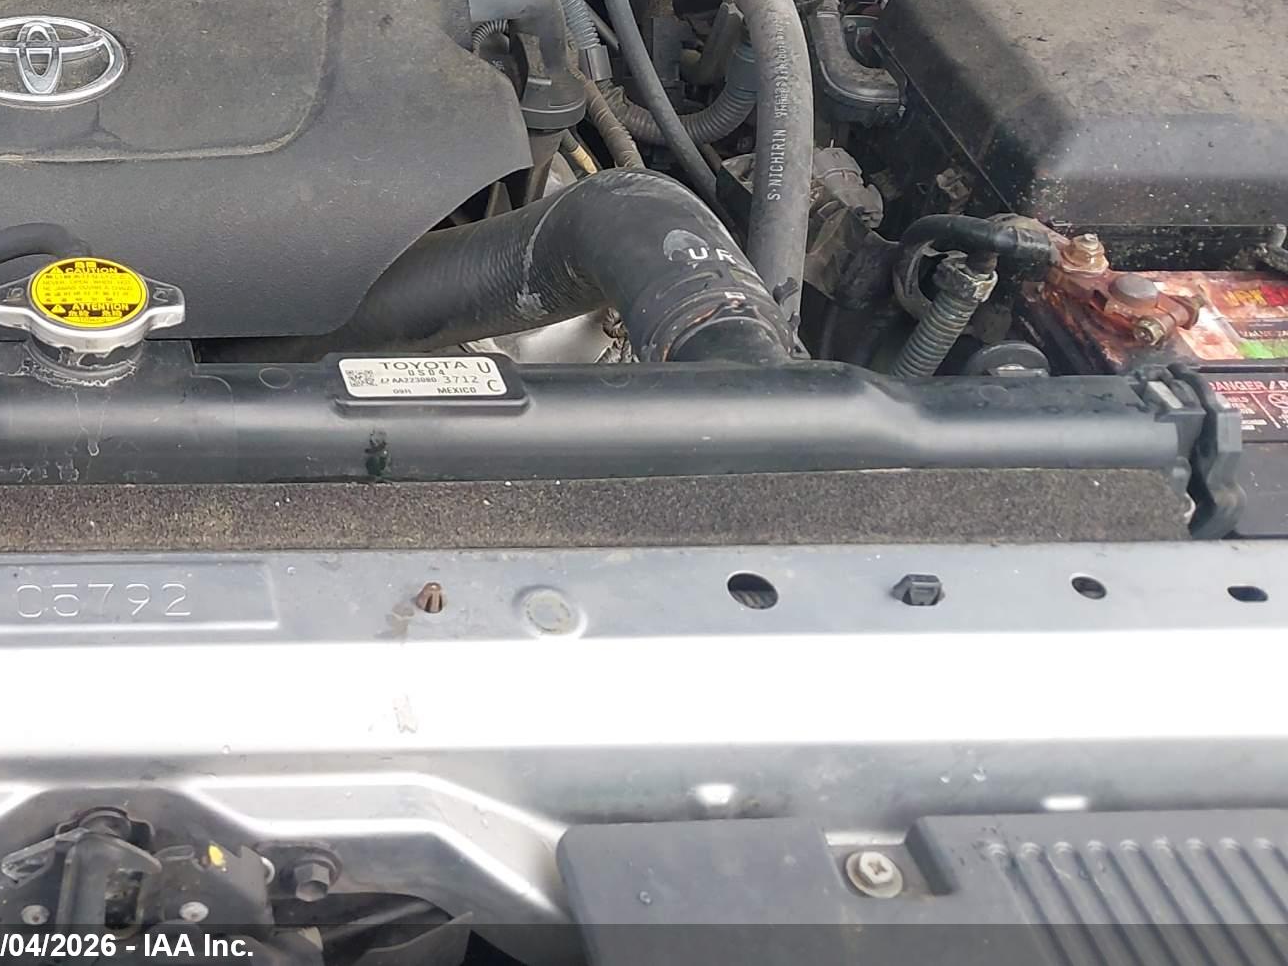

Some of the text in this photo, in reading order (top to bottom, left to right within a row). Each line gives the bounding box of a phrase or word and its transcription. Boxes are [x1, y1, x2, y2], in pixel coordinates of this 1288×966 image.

[72, 303, 129, 311] ATTENTION
[379, 361, 468, 371] TOYOTA
[444, 375, 480, 384] 3712
[437, 386, 477, 394] MEXICO
[486, 379, 502, 393] C
